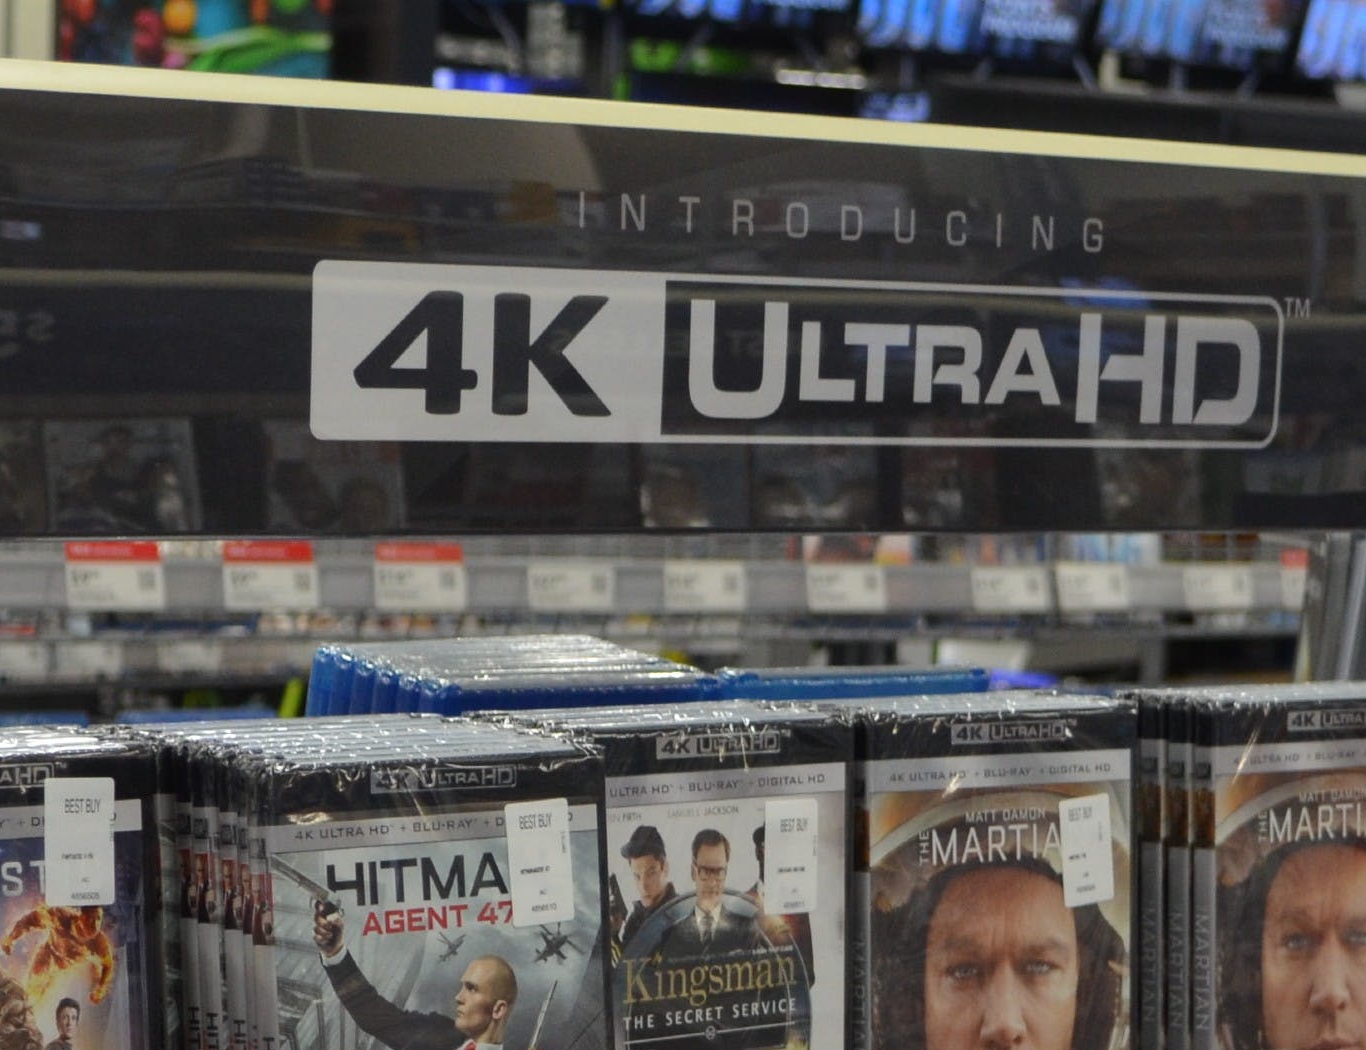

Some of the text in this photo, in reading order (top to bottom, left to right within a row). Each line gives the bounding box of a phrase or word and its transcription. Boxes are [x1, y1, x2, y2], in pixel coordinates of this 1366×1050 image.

[576, 189, 1107, 253] INTRODUCING
[352, 288, 612, 419] 4K
[609, 773, 825, 798] ULTRA HD BLU-RAY DIGITAL HD
[294, 818, 473, 841] 4K ULTRA HD BLU-RAY
[965, 807, 1047, 824] MATT DAMON
[918, 823, 1062, 867] THE MARTIA
[326, 851, 509, 907] HITMA
[361, 900, 514, 937] AGENT 47
[622, 954, 798, 1007] Kingsman
[622, 997, 796, 1032] THE SECRET SERVICE
